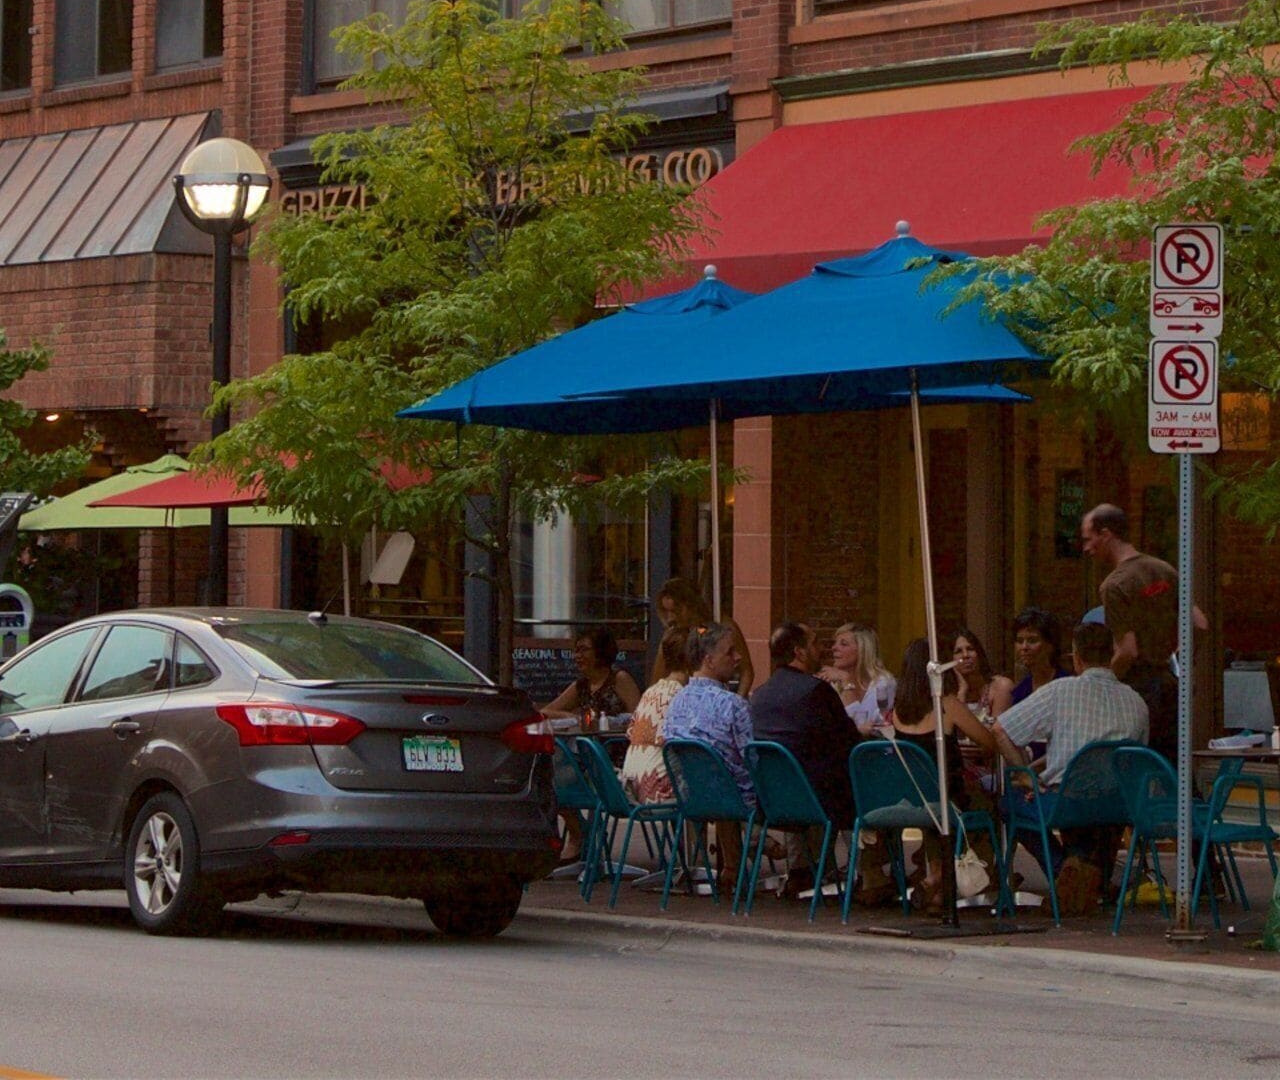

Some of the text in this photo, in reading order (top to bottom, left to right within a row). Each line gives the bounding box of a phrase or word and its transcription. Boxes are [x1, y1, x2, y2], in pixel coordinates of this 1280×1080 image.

[663, 151, 712, 188] CO
[1155, 411, 1178, 422] 3AM
[1192, 412, 1212, 422] 6AM
[1152, 428, 1215, 437] TOW AWAY ZONE
